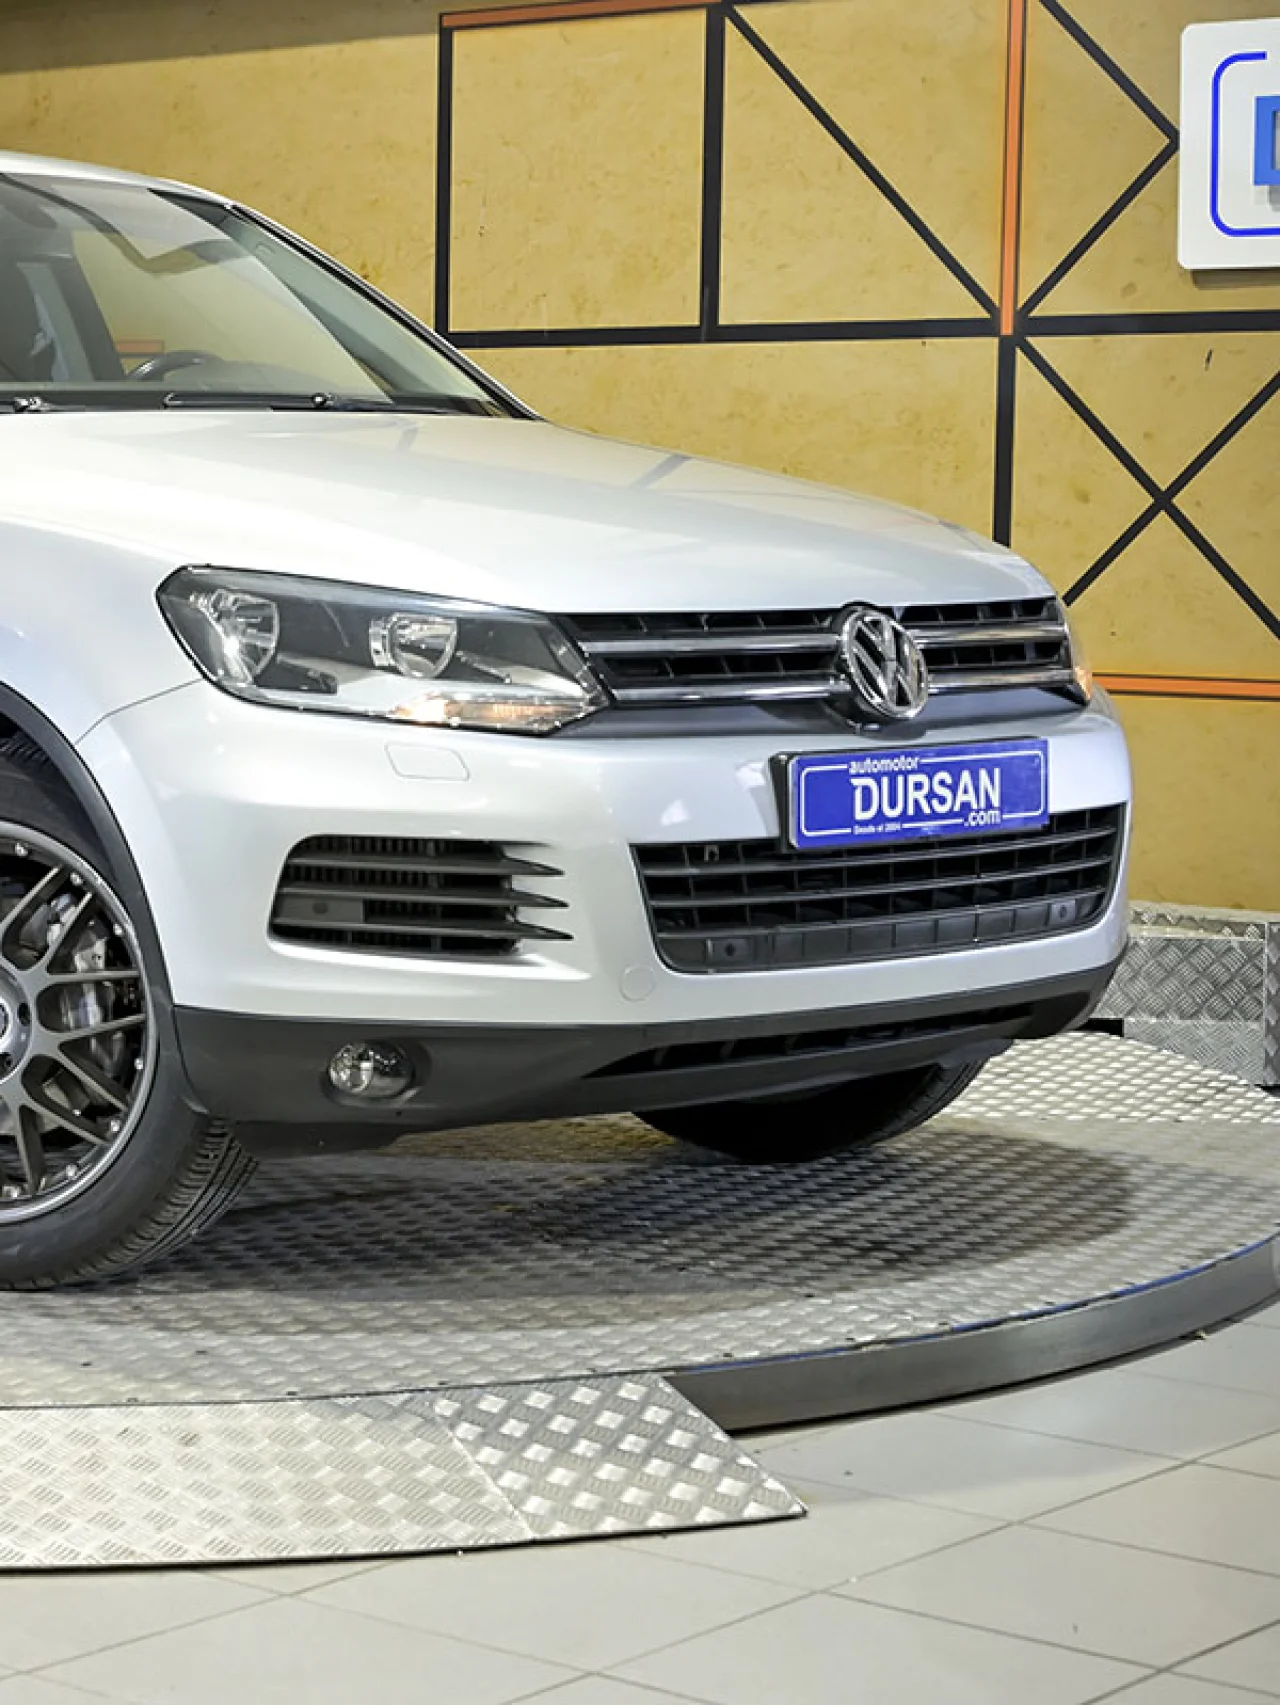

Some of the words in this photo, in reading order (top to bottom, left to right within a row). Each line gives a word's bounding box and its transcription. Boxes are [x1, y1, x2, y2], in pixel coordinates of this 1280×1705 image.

[849, 755, 919, 775] automotor
[850, 767, 1002, 821] DURSAN
[964, 808, 1001, 827] .com
